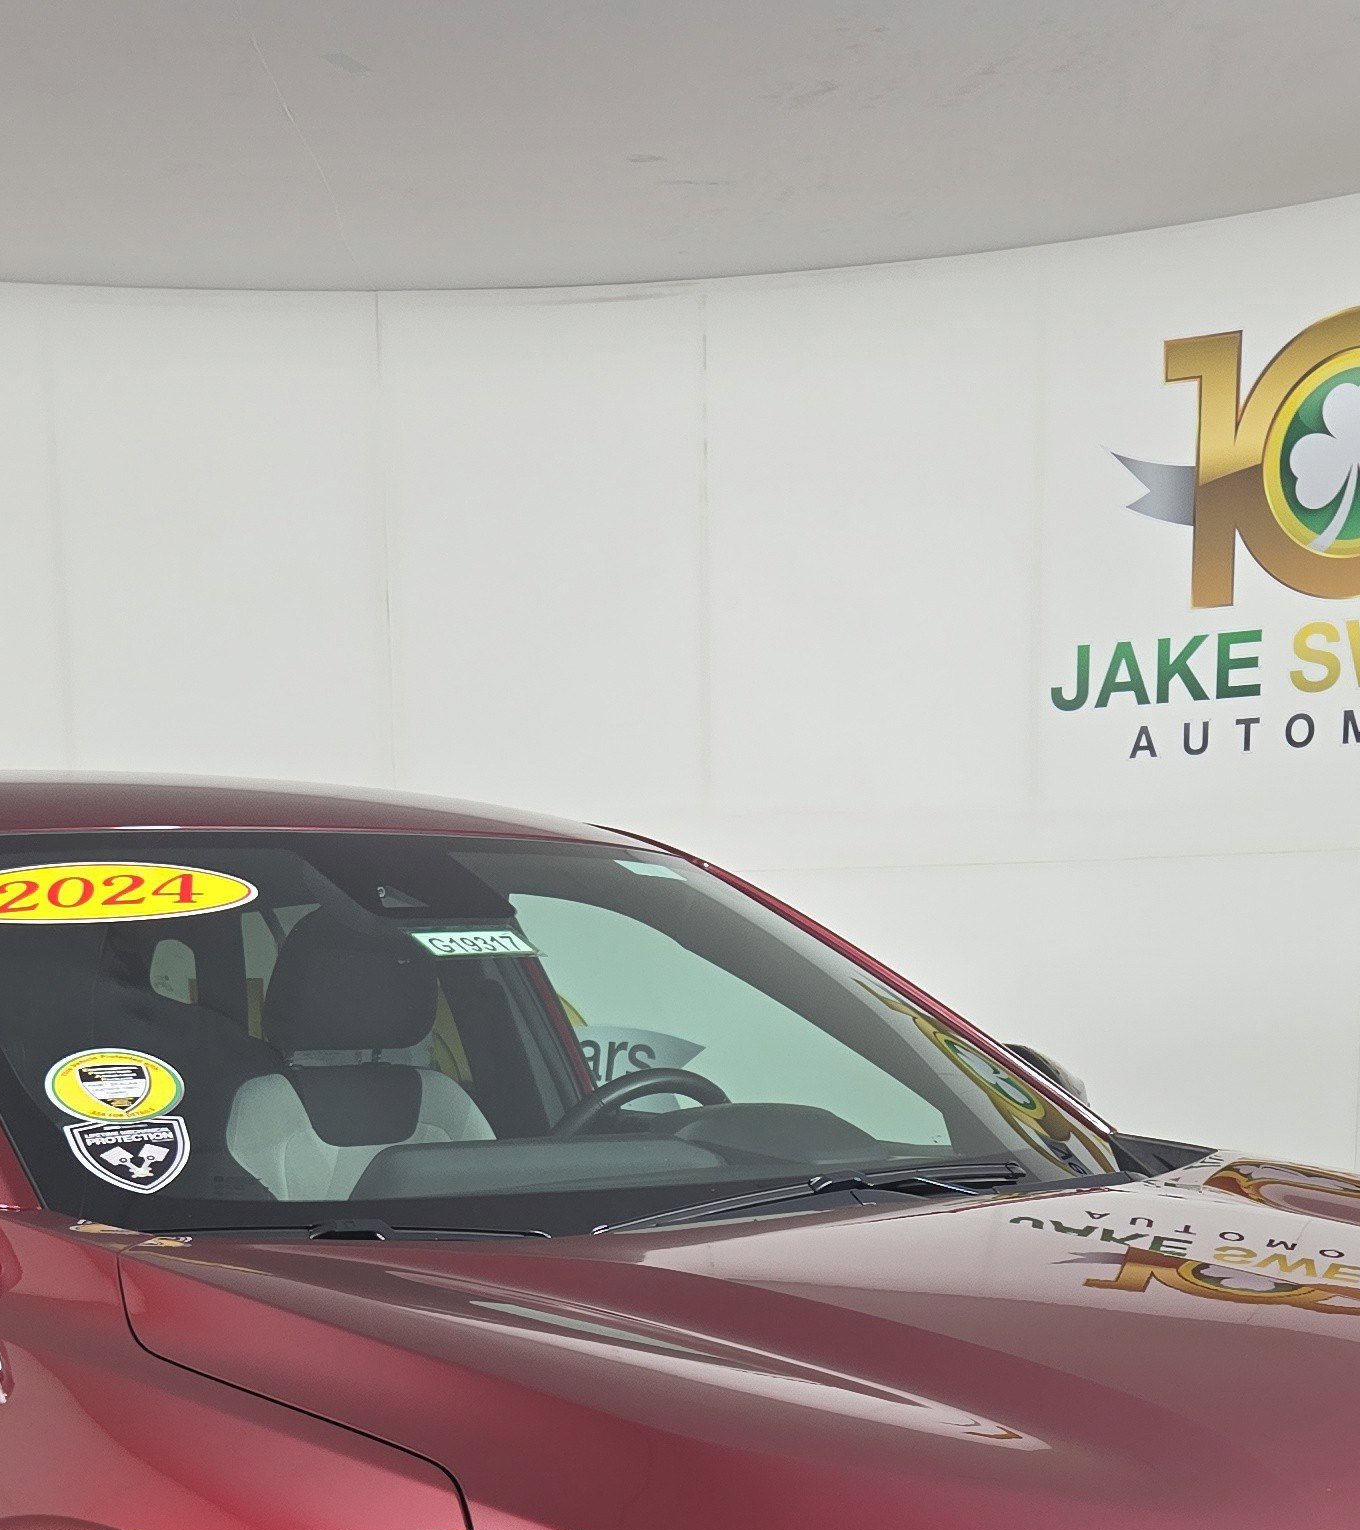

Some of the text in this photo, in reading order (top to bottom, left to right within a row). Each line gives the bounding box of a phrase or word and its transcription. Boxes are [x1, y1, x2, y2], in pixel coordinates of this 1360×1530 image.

[1051, 629, 1263, 712] JAKE
[428, 935, 521, 954] G19317
[85, 1131, 175, 1147] PROTECTION
